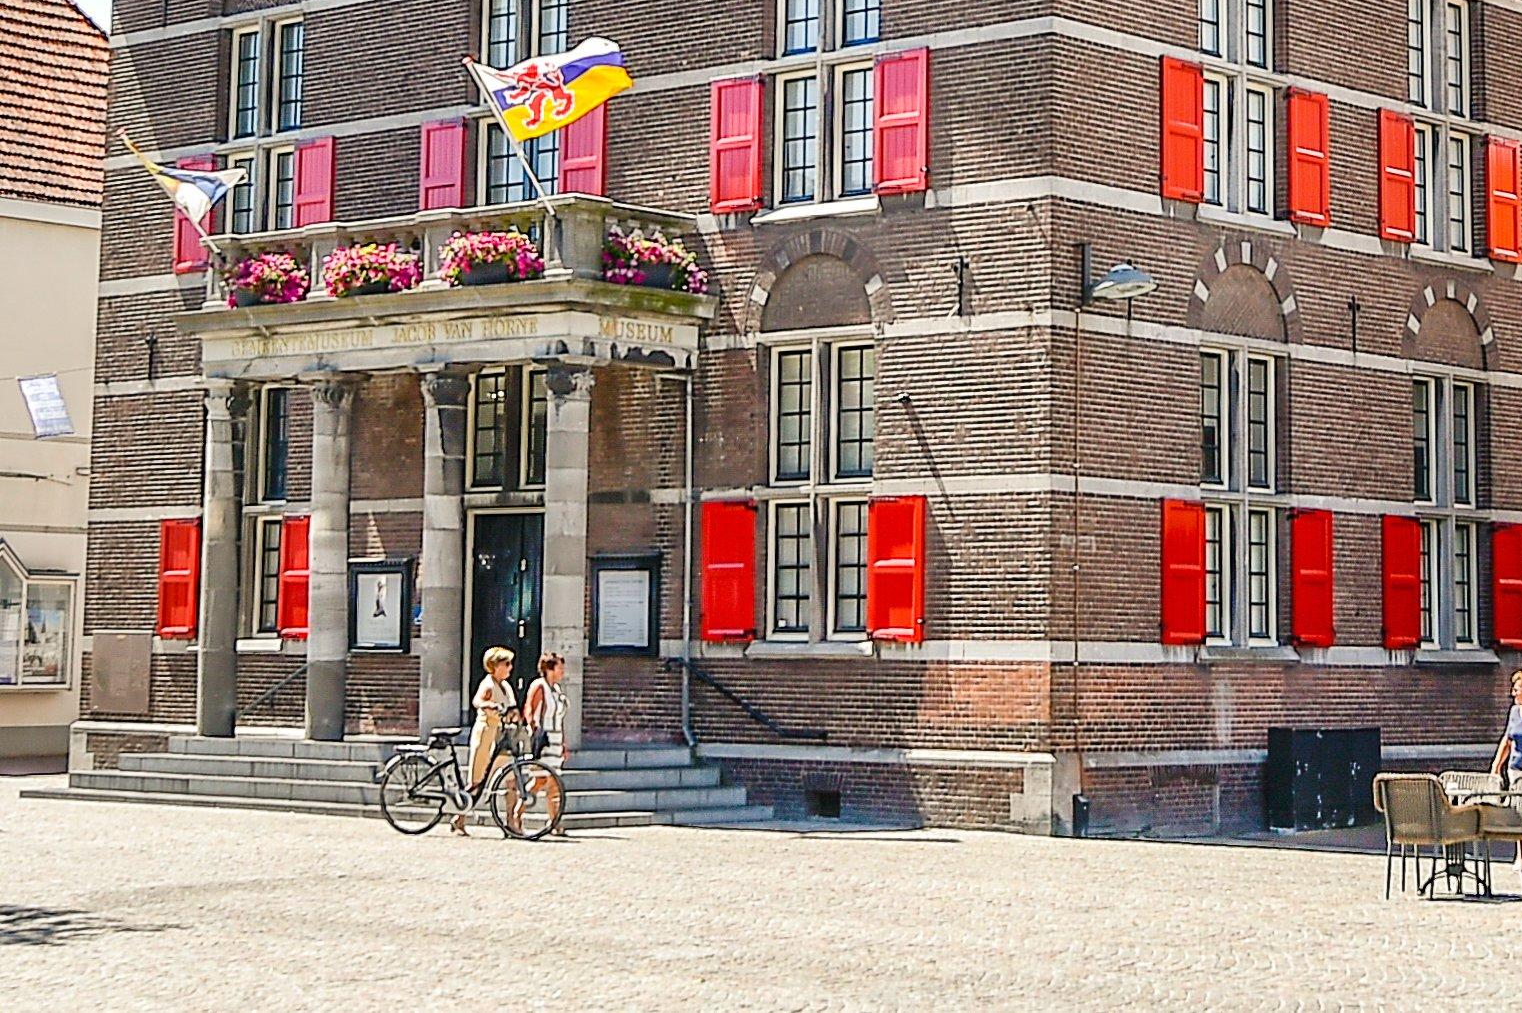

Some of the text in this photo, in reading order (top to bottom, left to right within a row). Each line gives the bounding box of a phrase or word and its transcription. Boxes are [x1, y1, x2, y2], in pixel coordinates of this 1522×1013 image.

[391, 322, 436, 343] JACOB
[443, 321, 473, 339] VAN
[600, 317, 673, 343] MUSEUM
